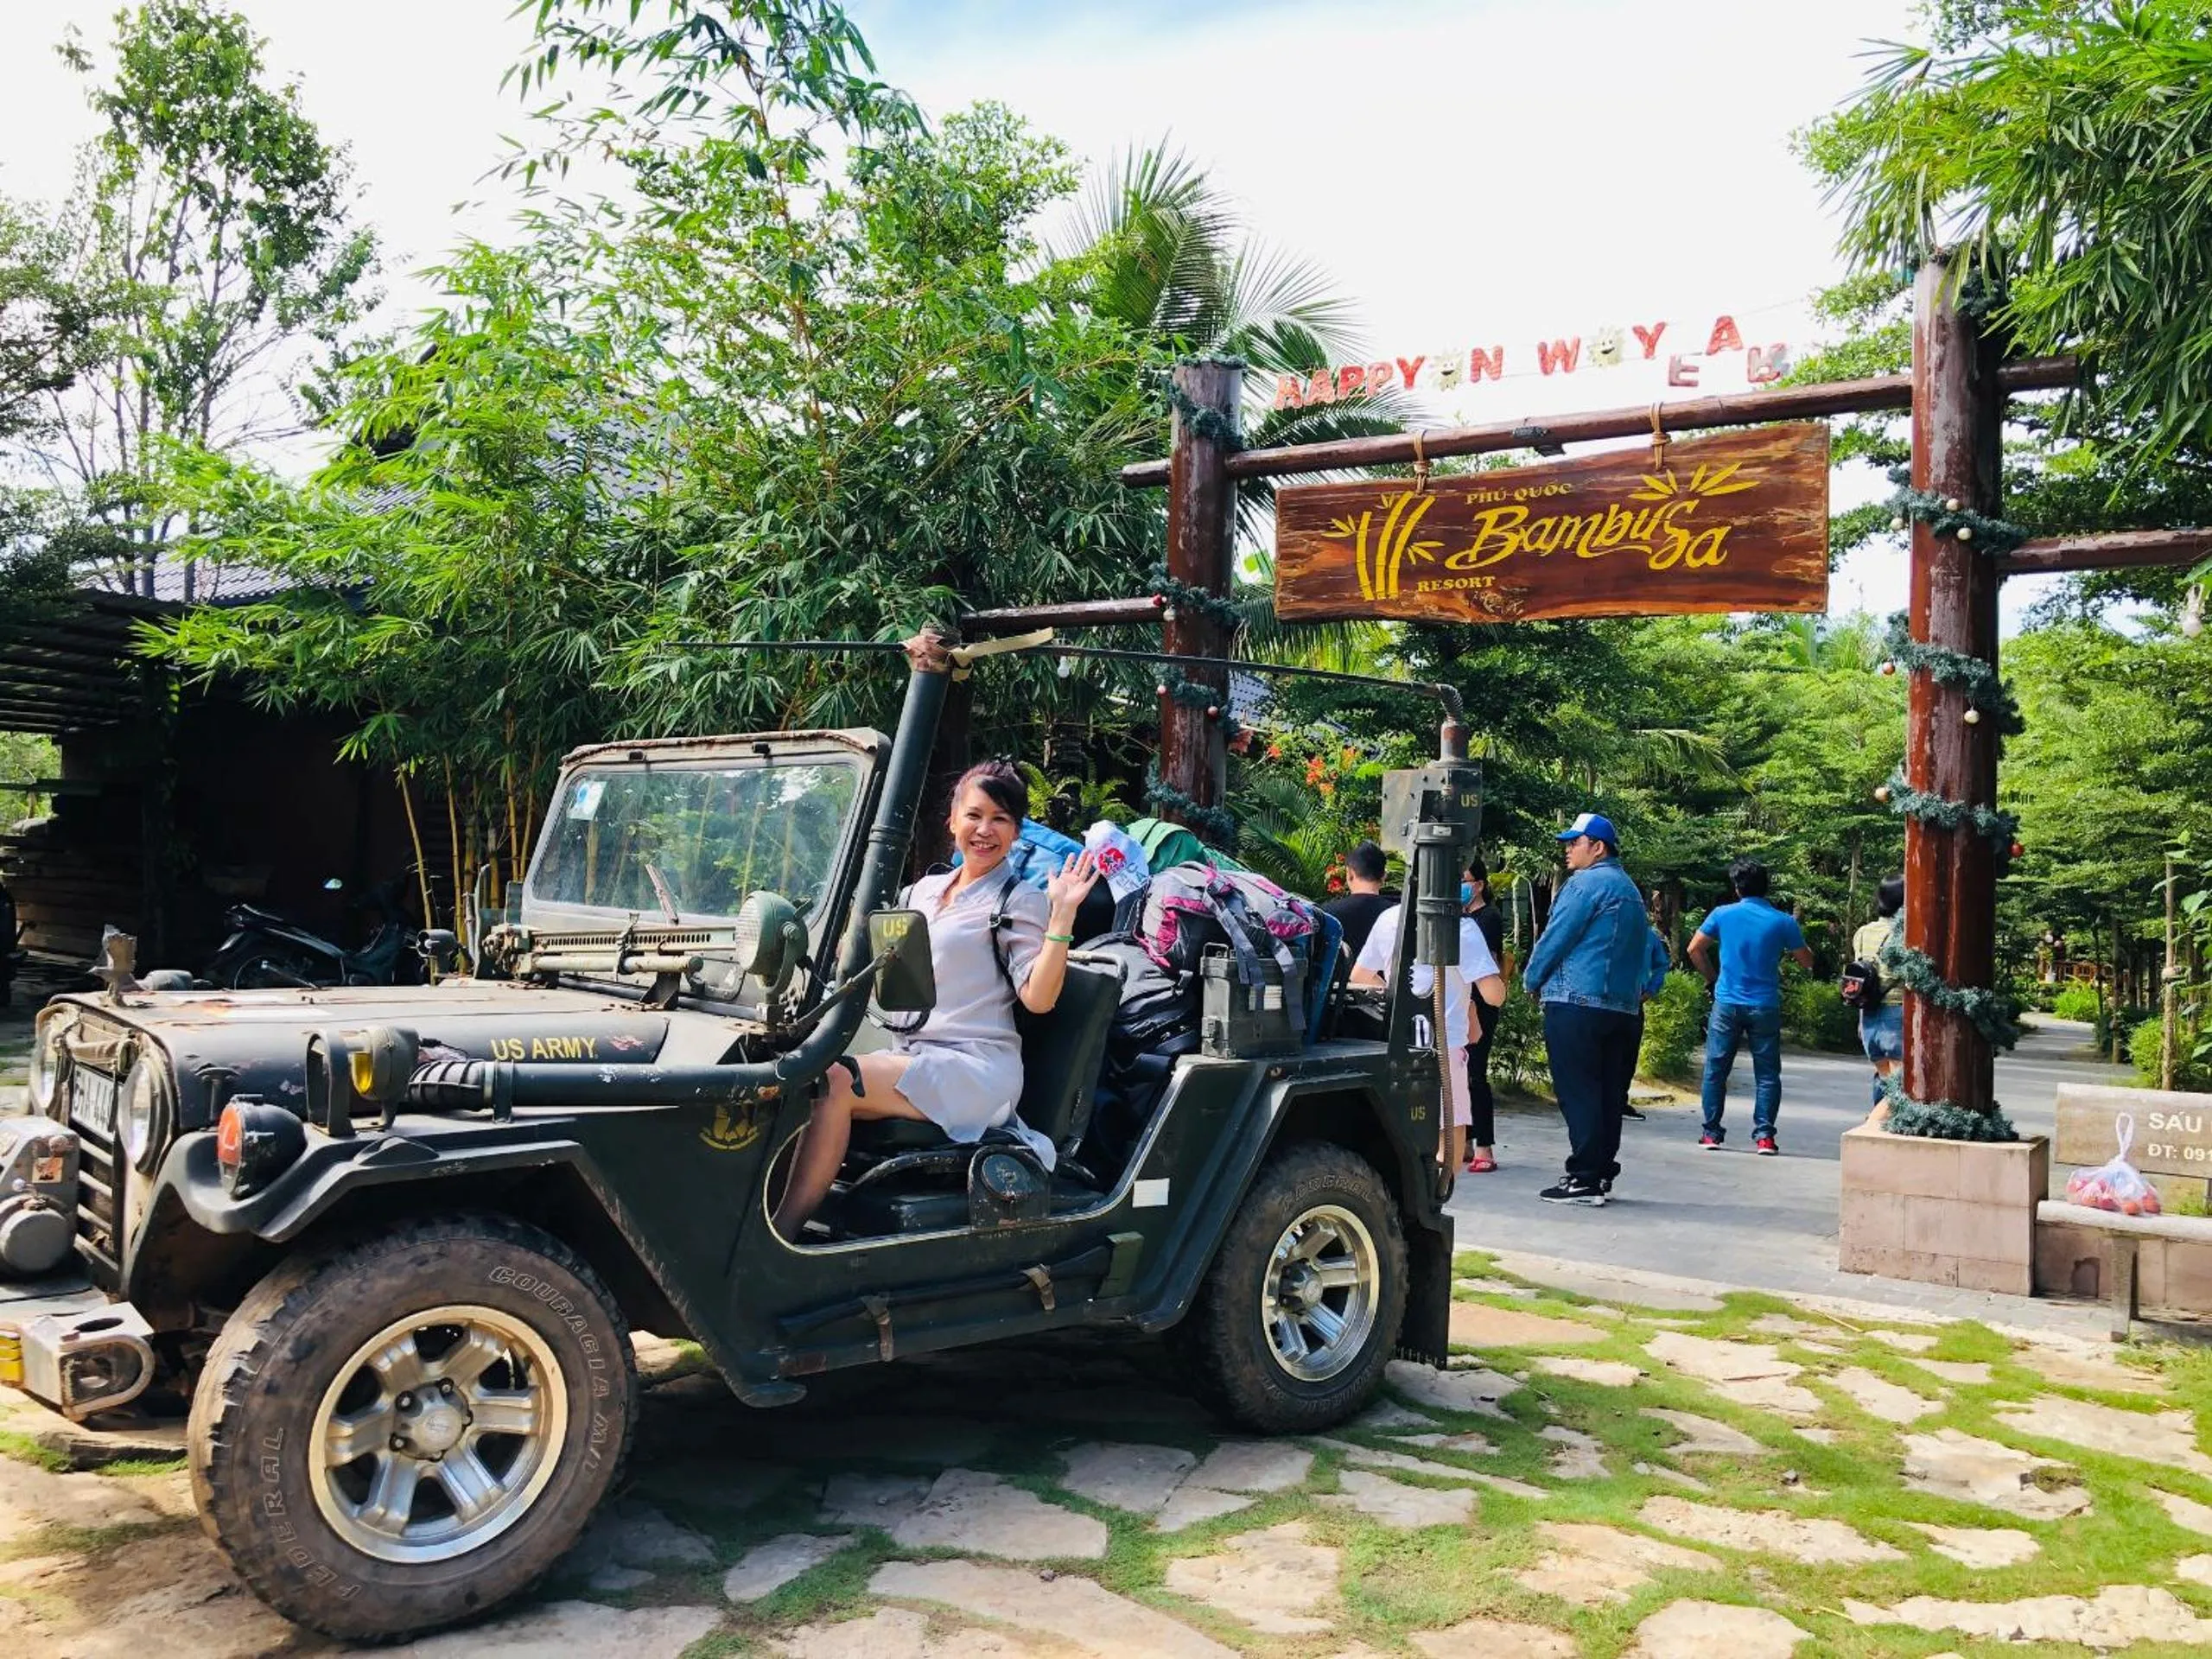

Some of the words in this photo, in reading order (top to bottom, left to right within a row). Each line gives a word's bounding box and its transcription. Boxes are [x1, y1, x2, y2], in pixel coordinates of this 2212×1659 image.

[1417, 575, 1496, 593] RESORT
[1460, 794, 1478, 808] US
[883, 917, 908, 937] US
[490, 1039, 525, 1061] US
[531, 1038, 596, 1059] ARMY
[1410, 1105, 1426, 1121] US
[261, 1427, 361, 1599] FEDERAL
